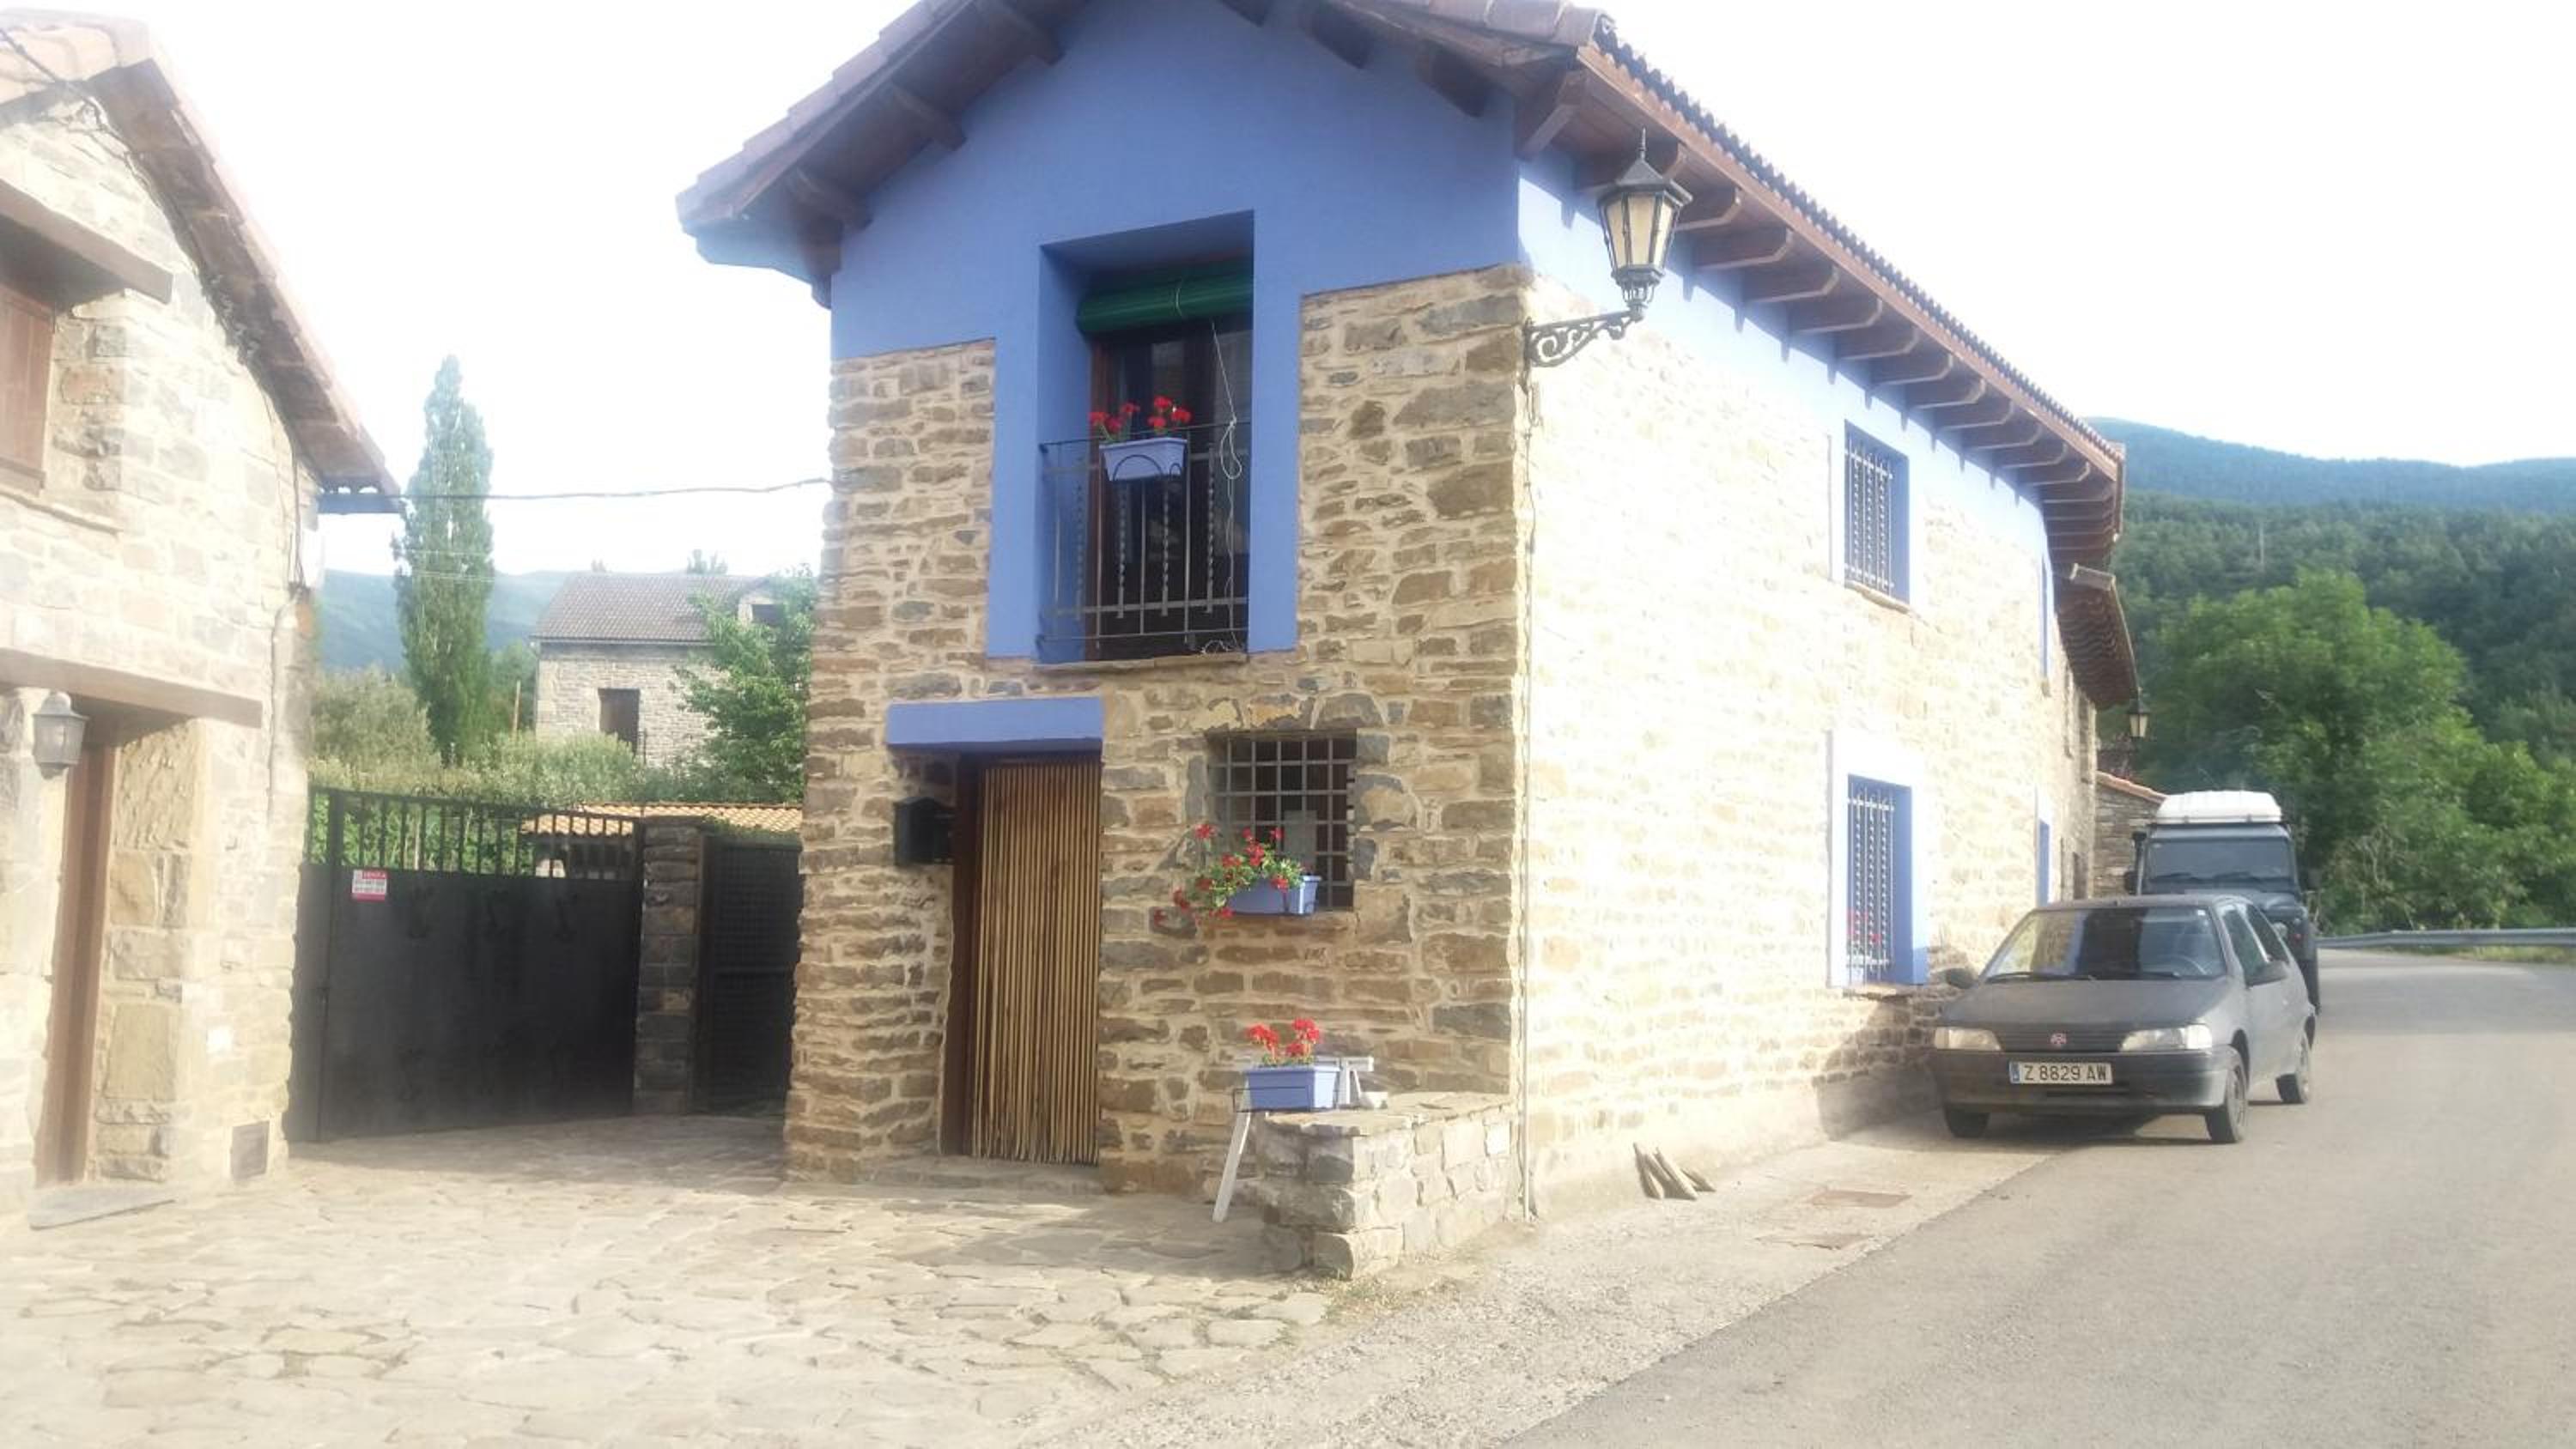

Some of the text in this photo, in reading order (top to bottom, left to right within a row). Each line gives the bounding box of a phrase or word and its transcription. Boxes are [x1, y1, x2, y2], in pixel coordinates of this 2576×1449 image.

[2024, 1065, 2106, 1081] Z 8829 AW
